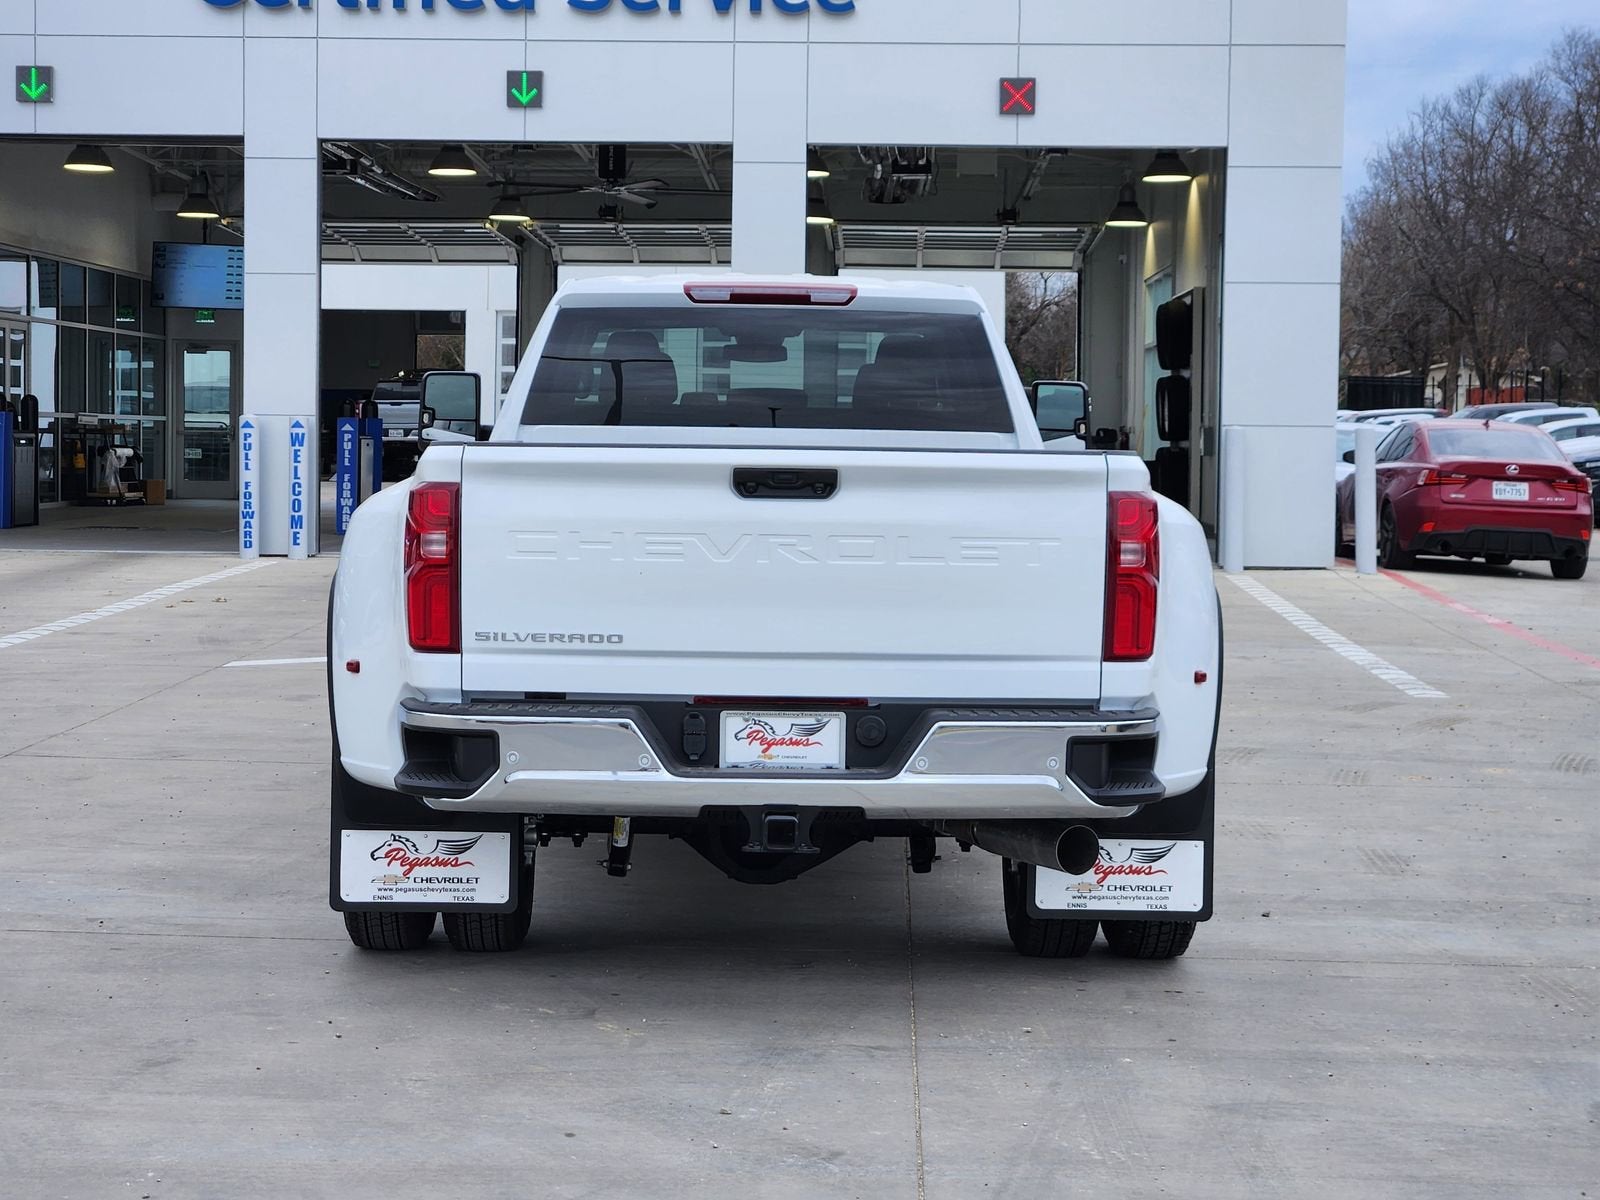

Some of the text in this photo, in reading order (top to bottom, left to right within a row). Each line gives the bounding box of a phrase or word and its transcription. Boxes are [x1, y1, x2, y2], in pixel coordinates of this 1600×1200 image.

[343, 433, 352, 466] PULL
[241, 432, 255, 549] PULL FORWARD
[290, 432, 306, 546] WELCOME
[507, 530, 1061, 567] CHEVROLET
[474, 631, 624, 644] SILVERADO
[746, 729, 823, 754] Pegasus
[384, 847, 475, 877] Pegasus
[377, 886, 477, 894] www.pegasuschevytexas.com
[413, 876, 481, 885] CHEVROLET
[1107, 884, 1174, 893] CHEVROLET
[1071, 894, 1170, 902] www.pegasuschevytexas.com
